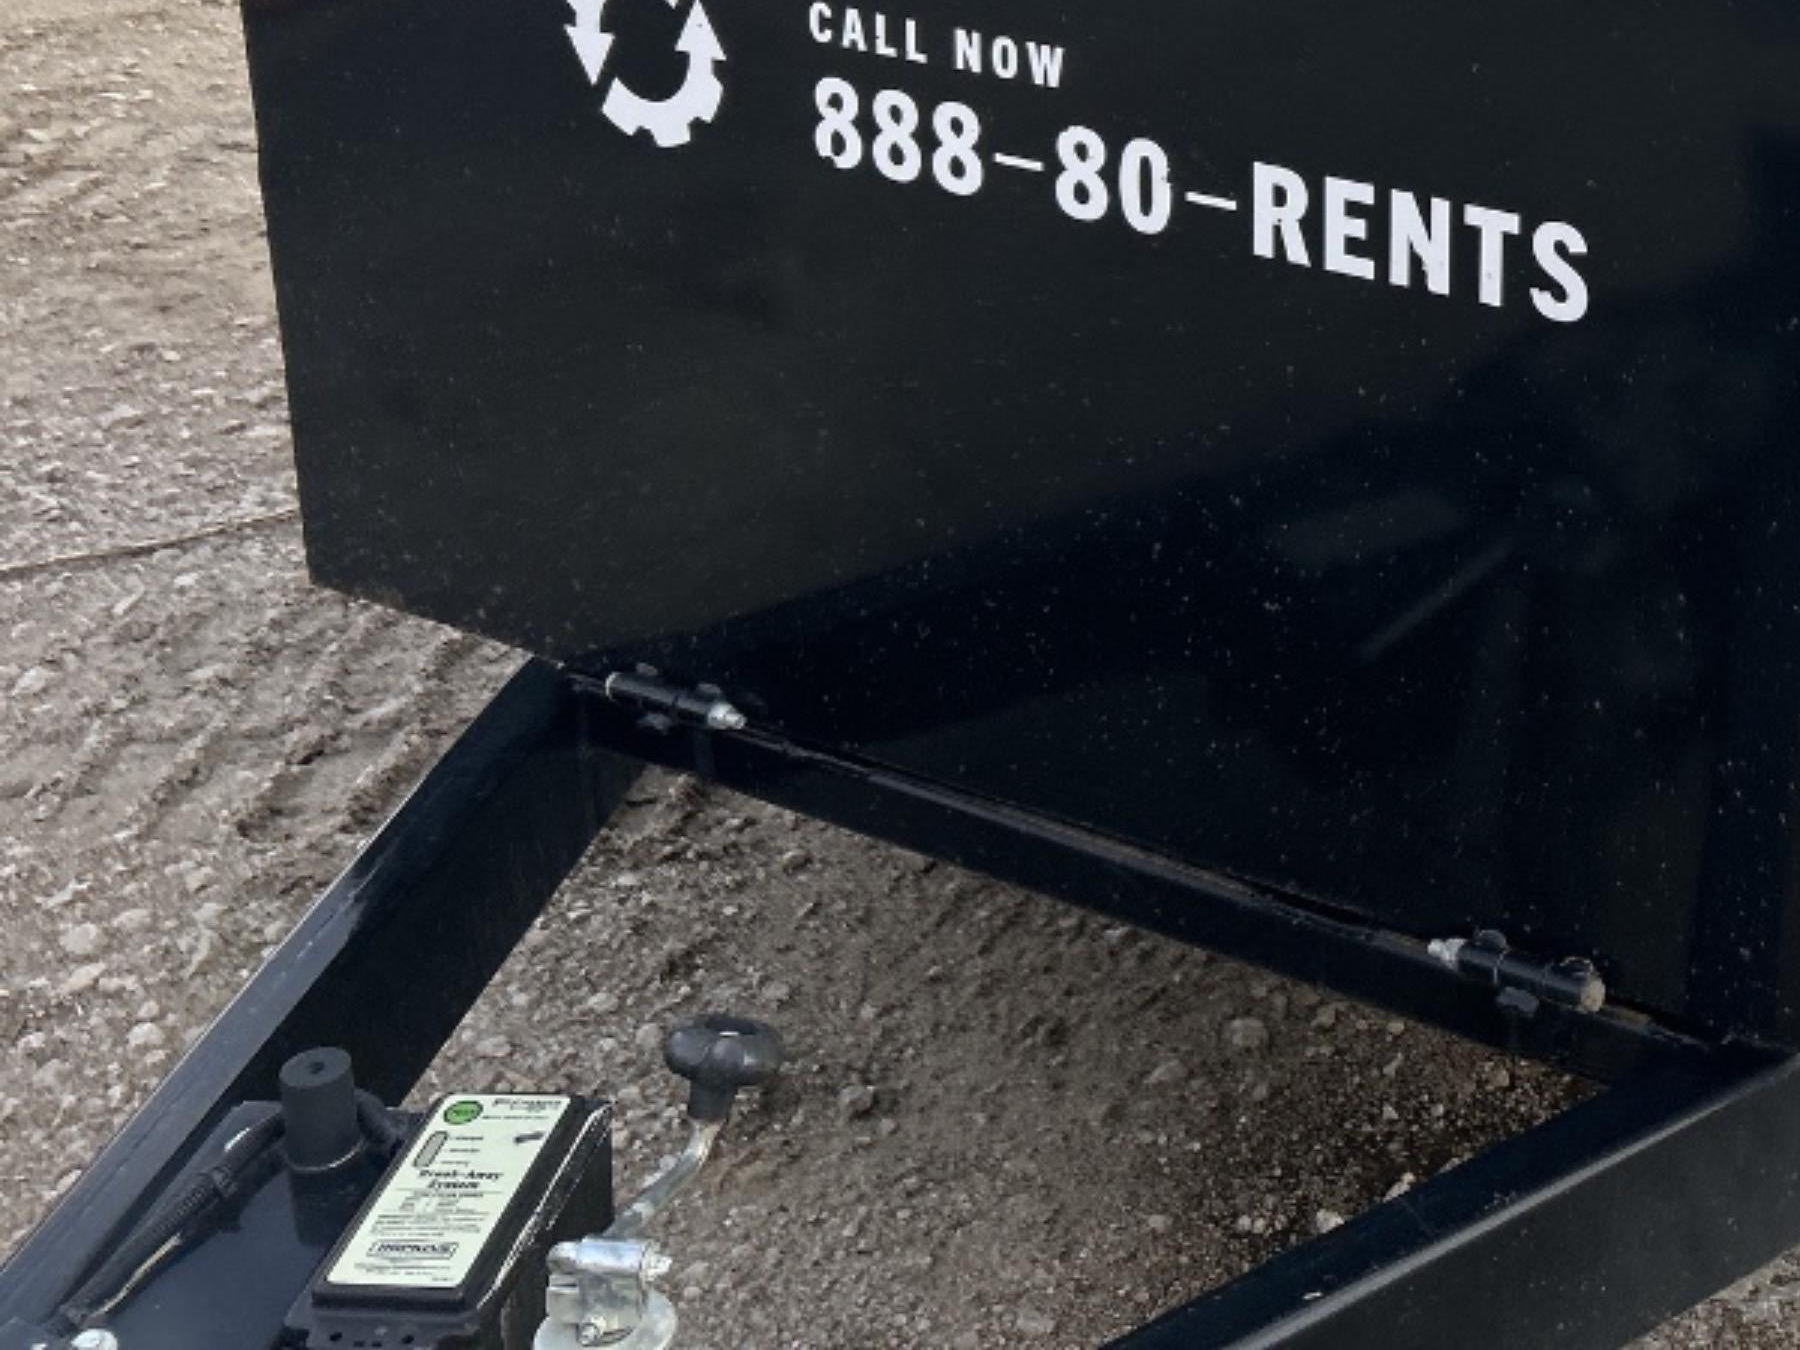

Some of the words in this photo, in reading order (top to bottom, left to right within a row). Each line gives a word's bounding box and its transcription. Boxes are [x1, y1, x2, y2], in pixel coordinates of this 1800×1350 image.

[808, 1, 927, 65] CALL
[954, 28, 1066, 88] NOW
[813, 76, 1590, 323] 888-80-RENTS
